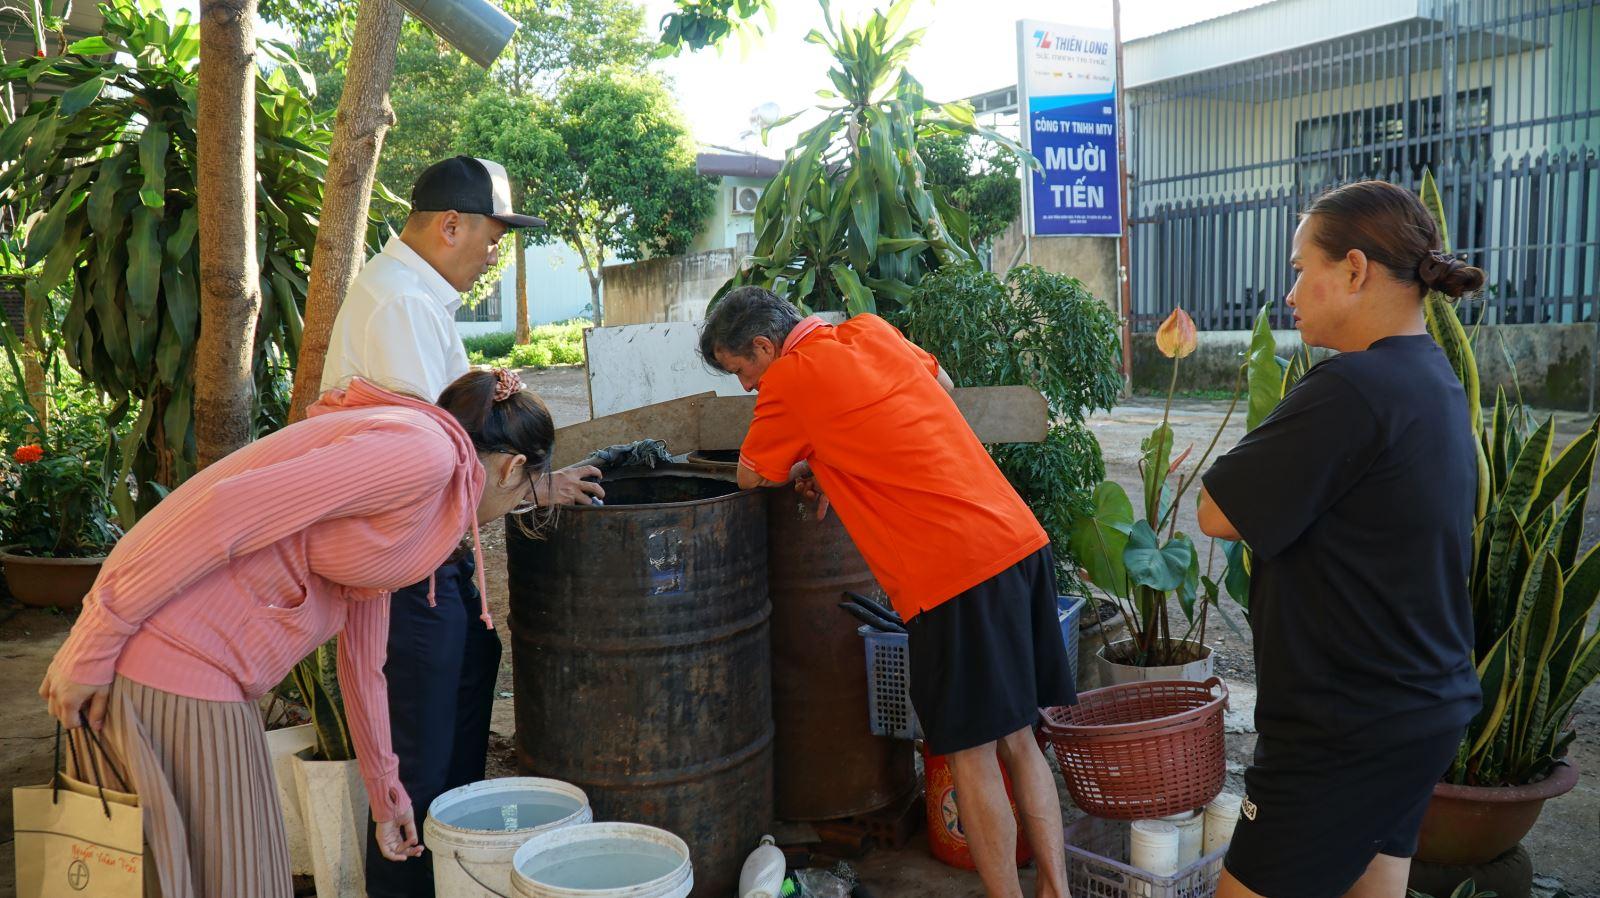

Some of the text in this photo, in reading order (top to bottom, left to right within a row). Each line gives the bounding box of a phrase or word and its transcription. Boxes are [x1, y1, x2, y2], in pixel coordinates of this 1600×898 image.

[1083, 40, 1109, 55] LONG
[1035, 116, 1113, 136] CÔNG TY TNHH MTV
[1045, 141, 1106, 172] MƯỜI
[1050, 175, 1105, 208] TIẾN
